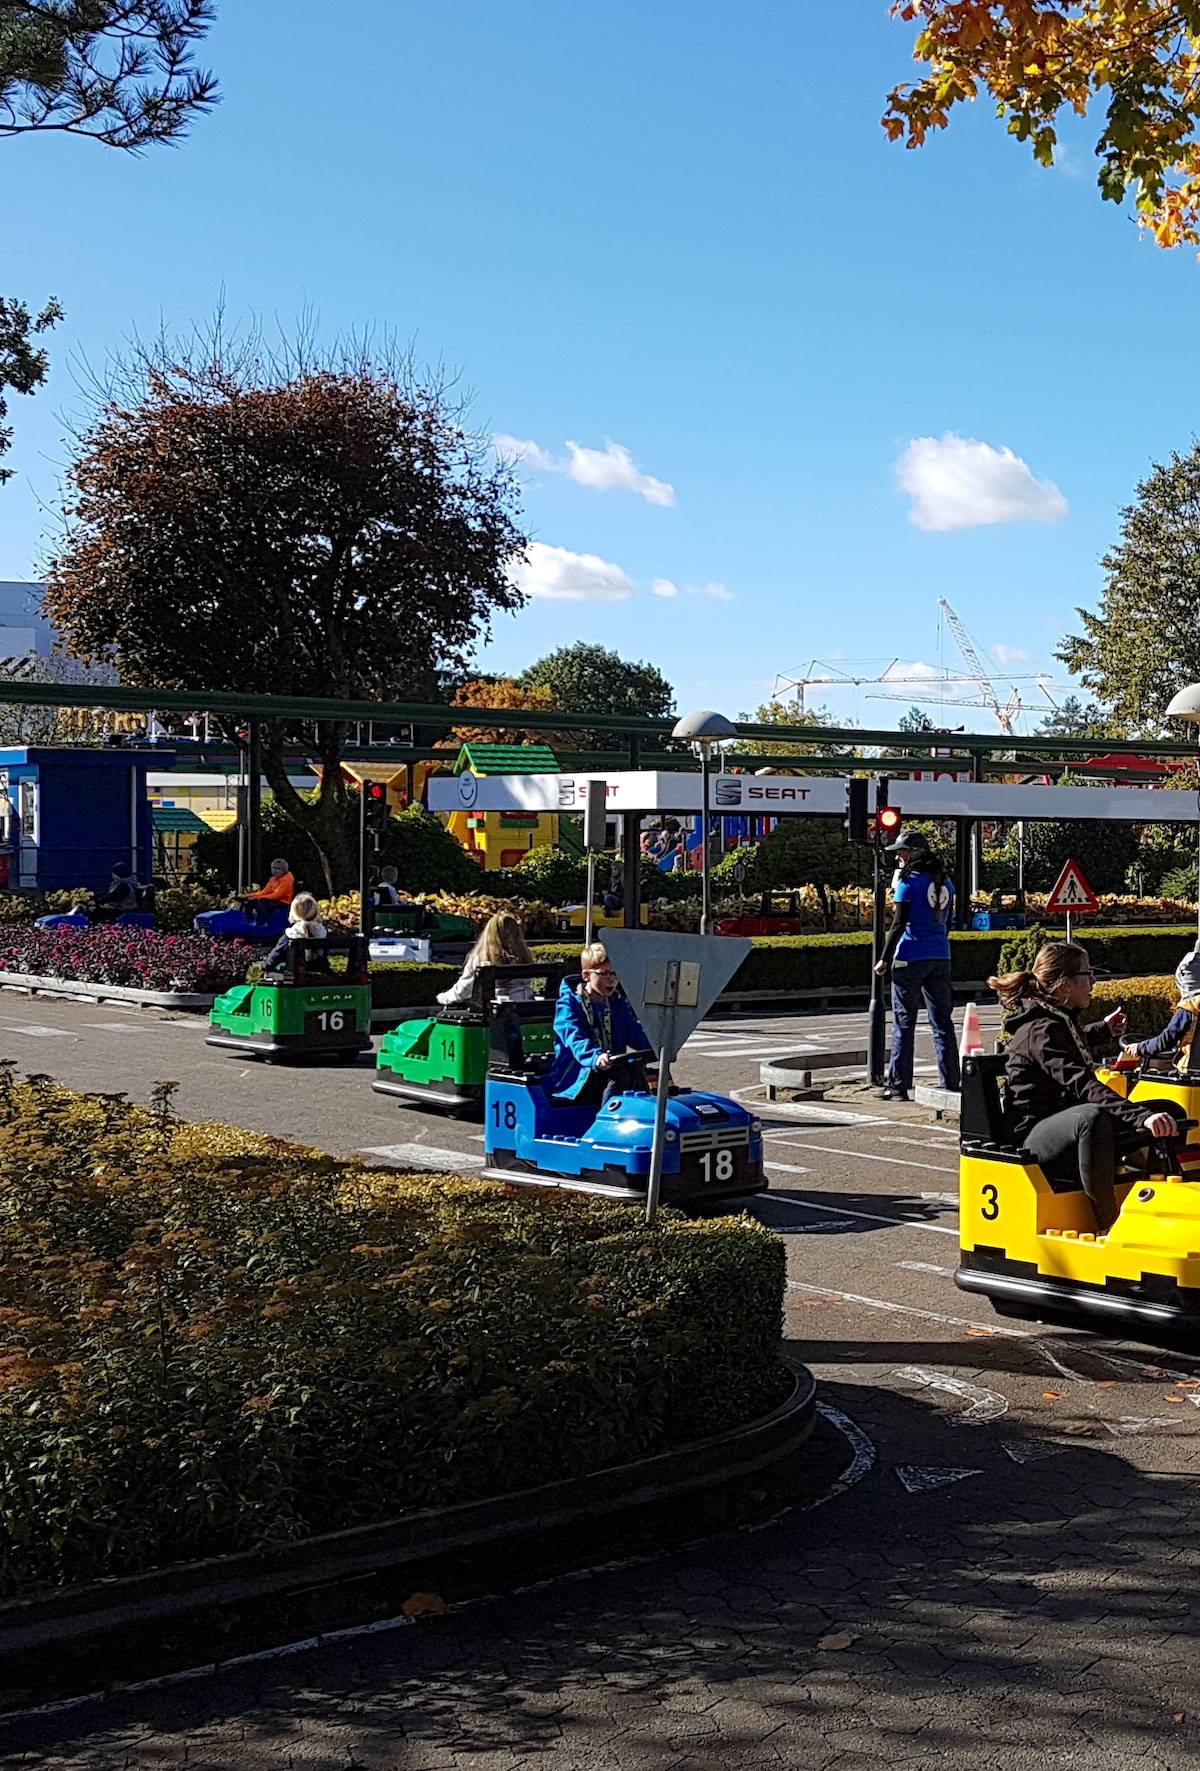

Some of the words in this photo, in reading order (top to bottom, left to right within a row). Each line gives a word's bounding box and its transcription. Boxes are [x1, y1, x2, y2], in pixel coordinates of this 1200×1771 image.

[748, 787, 811, 801] SEAT
[260, 999, 273, 1017] 16
[317, 1011, 344, 1031] 16
[441, 1039, 456, 1061] 14
[490, 1101, 518, 1130] 18
[699, 1149, 734, 1183] 18
[981, 1184, 1000, 1221] 3
